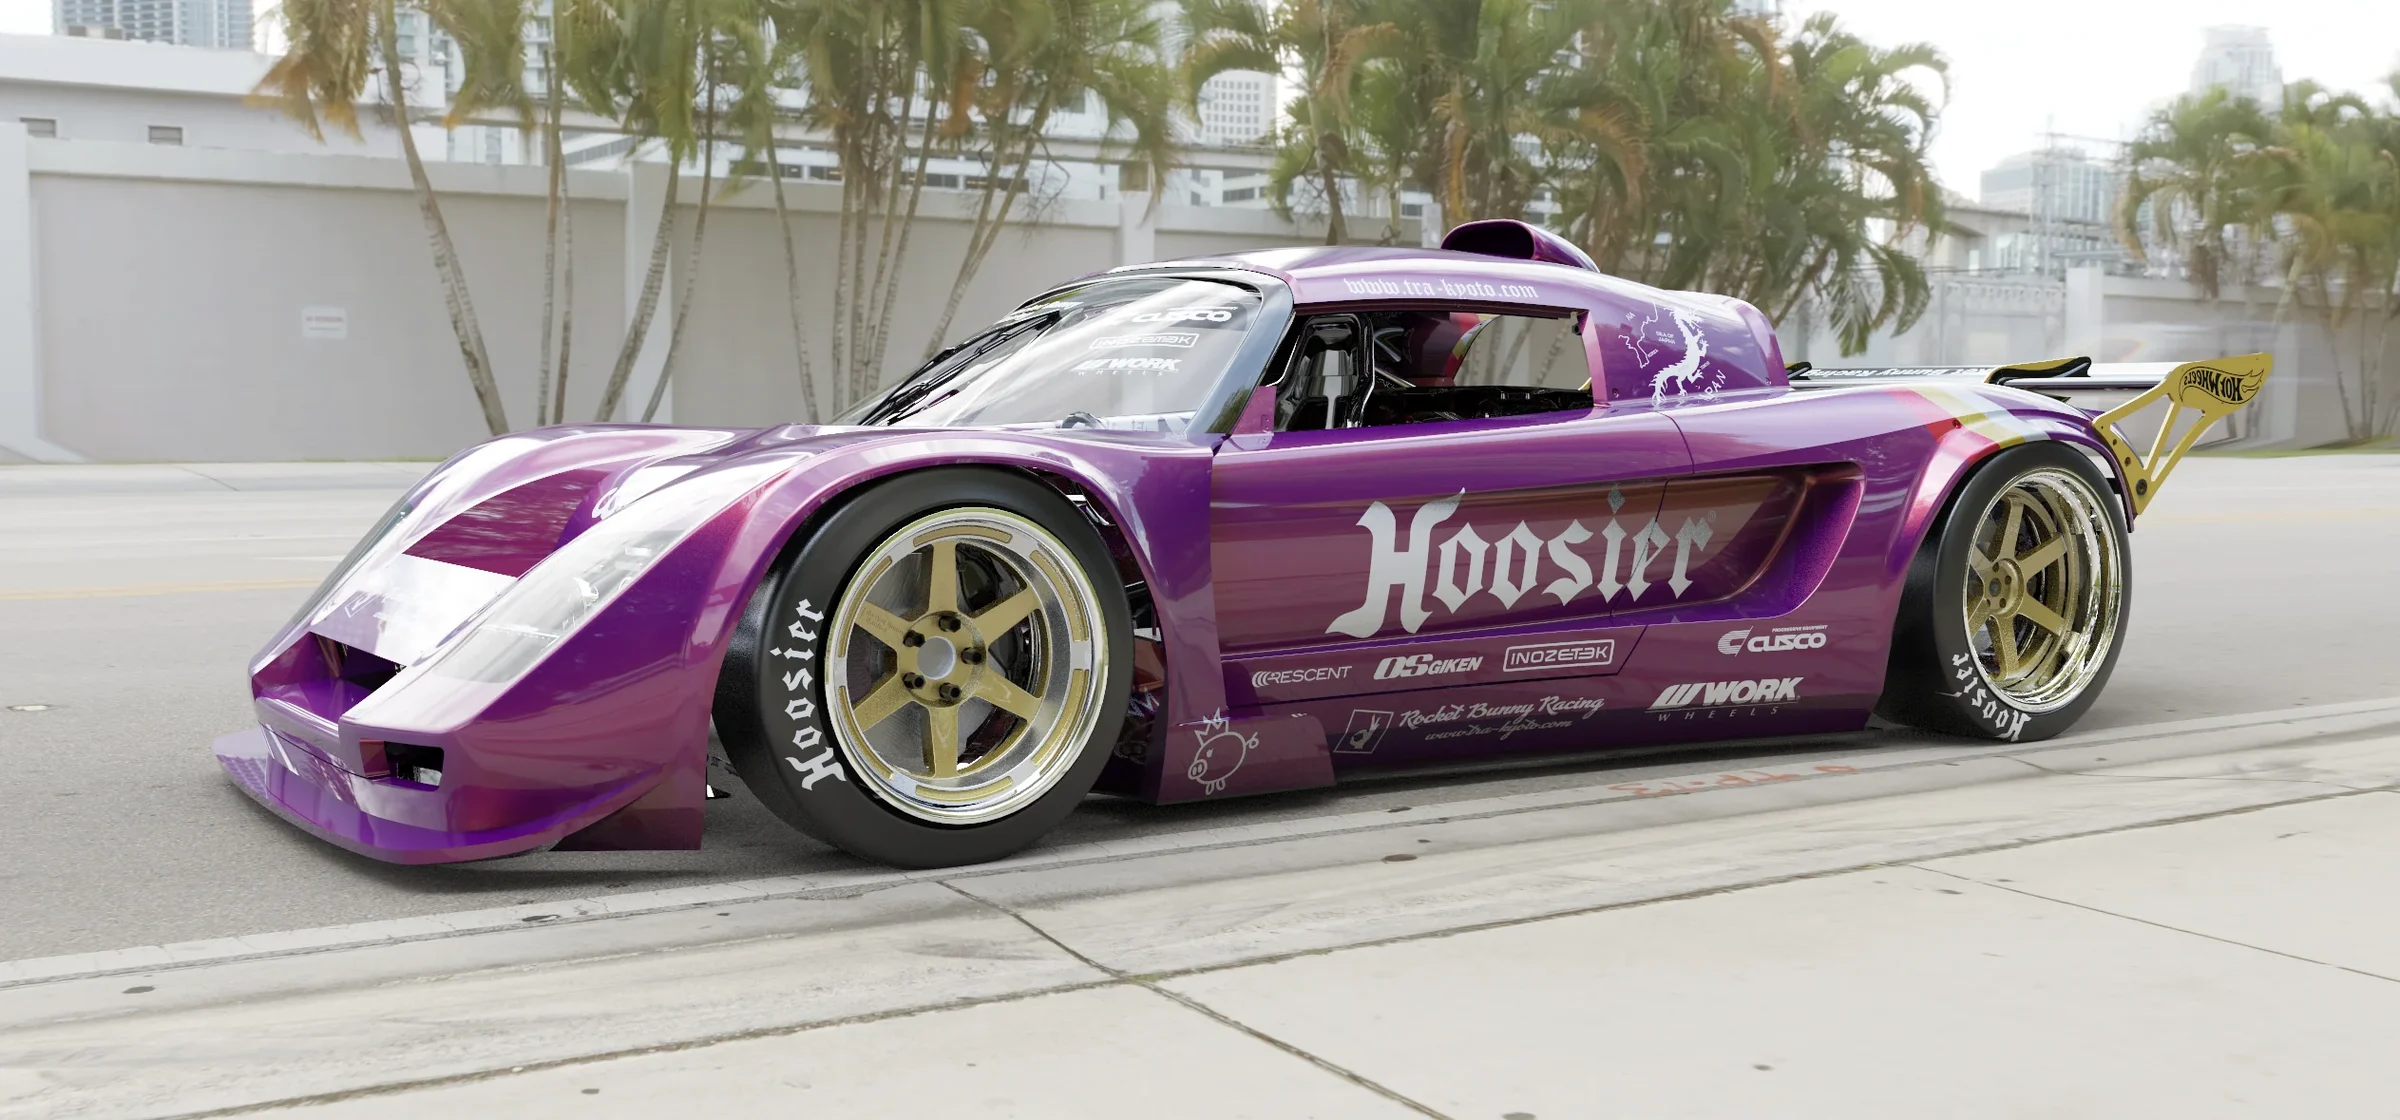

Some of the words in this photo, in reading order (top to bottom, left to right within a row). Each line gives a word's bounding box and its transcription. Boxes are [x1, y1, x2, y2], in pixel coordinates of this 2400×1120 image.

[1343, 277, 1540, 299] www.tra-kyoto.com
[1107, 358, 1183, 371] WORK
[1325, 487, 1714, 639] Hoosier
[1747, 632, 1827, 652] CUSCO
[770, 598, 847, 791] Hoosier
[1702, 676, 1804, 706] WORK
[1938, 652, 2032, 742] Hoosier
[1399, 703, 1465, 730] Rocket
[1467, 702, 1535, 725] Bunny
[1538, 695, 1606, 720] Racing
[1657, 706, 1779, 722] WHEELS
[1424, 718, 1573, 741] www.tra-kyoto.com
